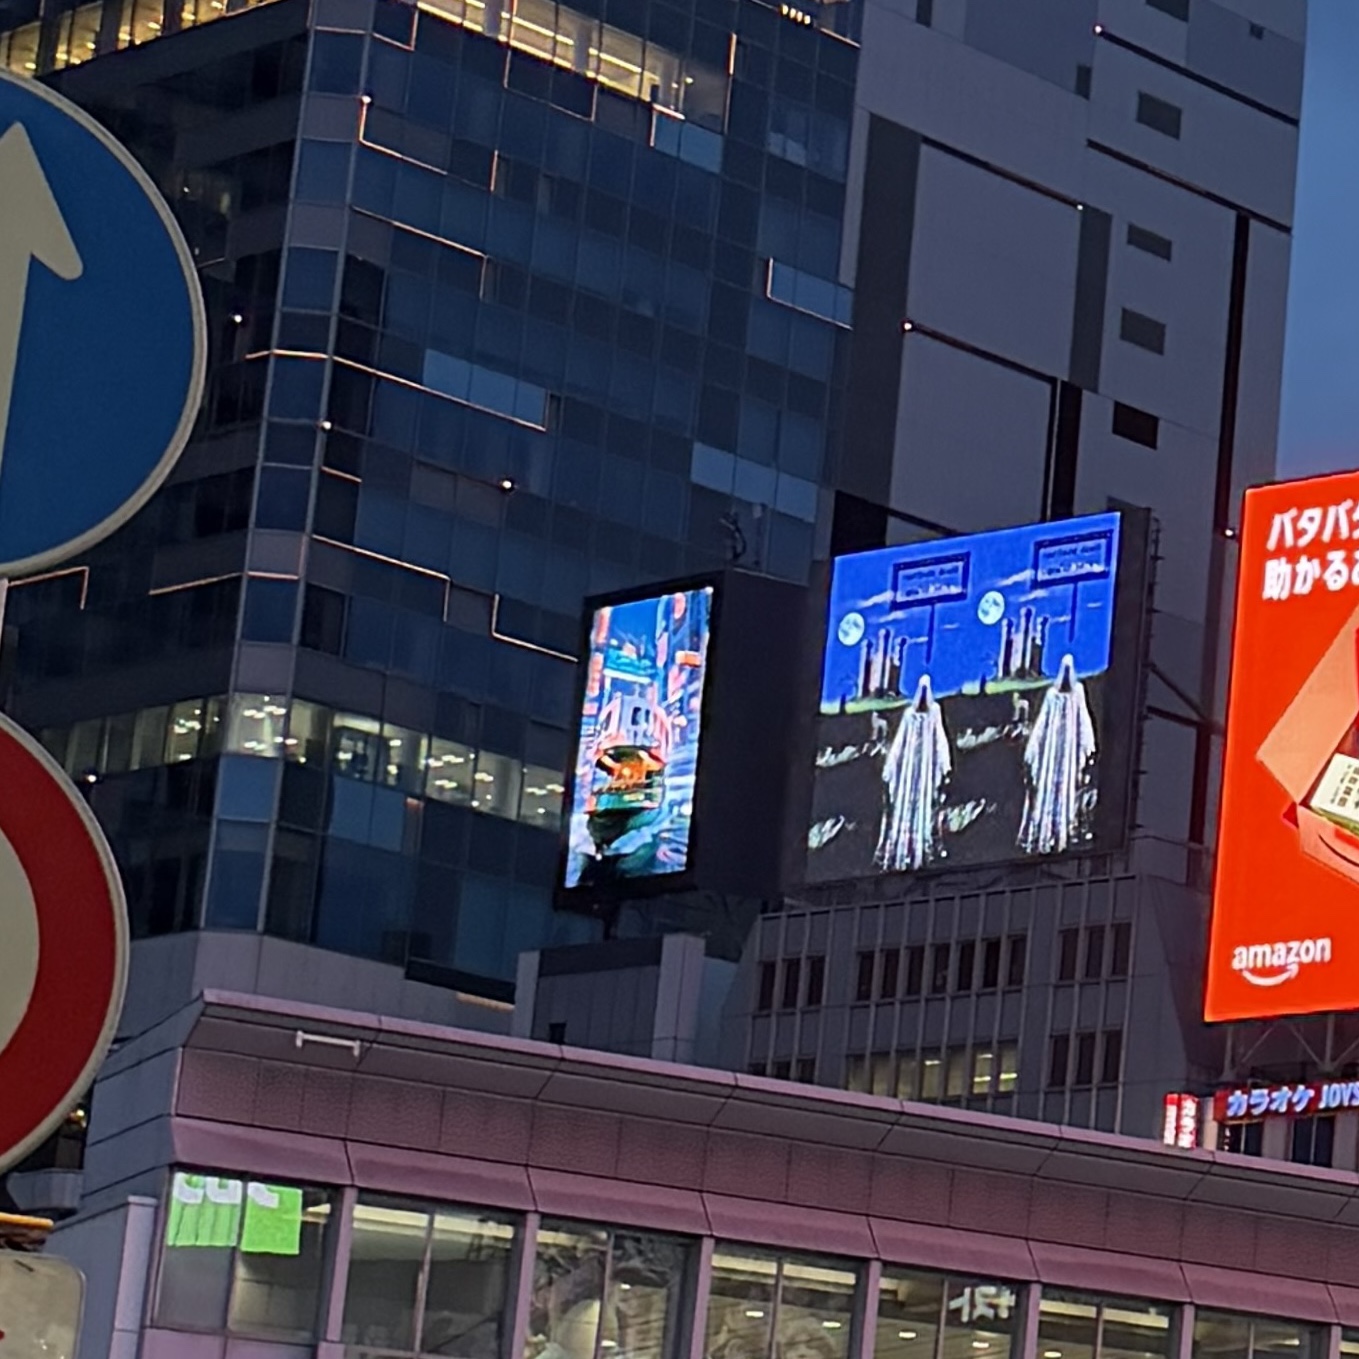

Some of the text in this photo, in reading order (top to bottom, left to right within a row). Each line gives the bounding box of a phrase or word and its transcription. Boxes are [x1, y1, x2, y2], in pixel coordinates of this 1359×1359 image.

[1231, 936, 1332, 972] amazon
[1226, 1085, 1316, 1118] カラオケ
